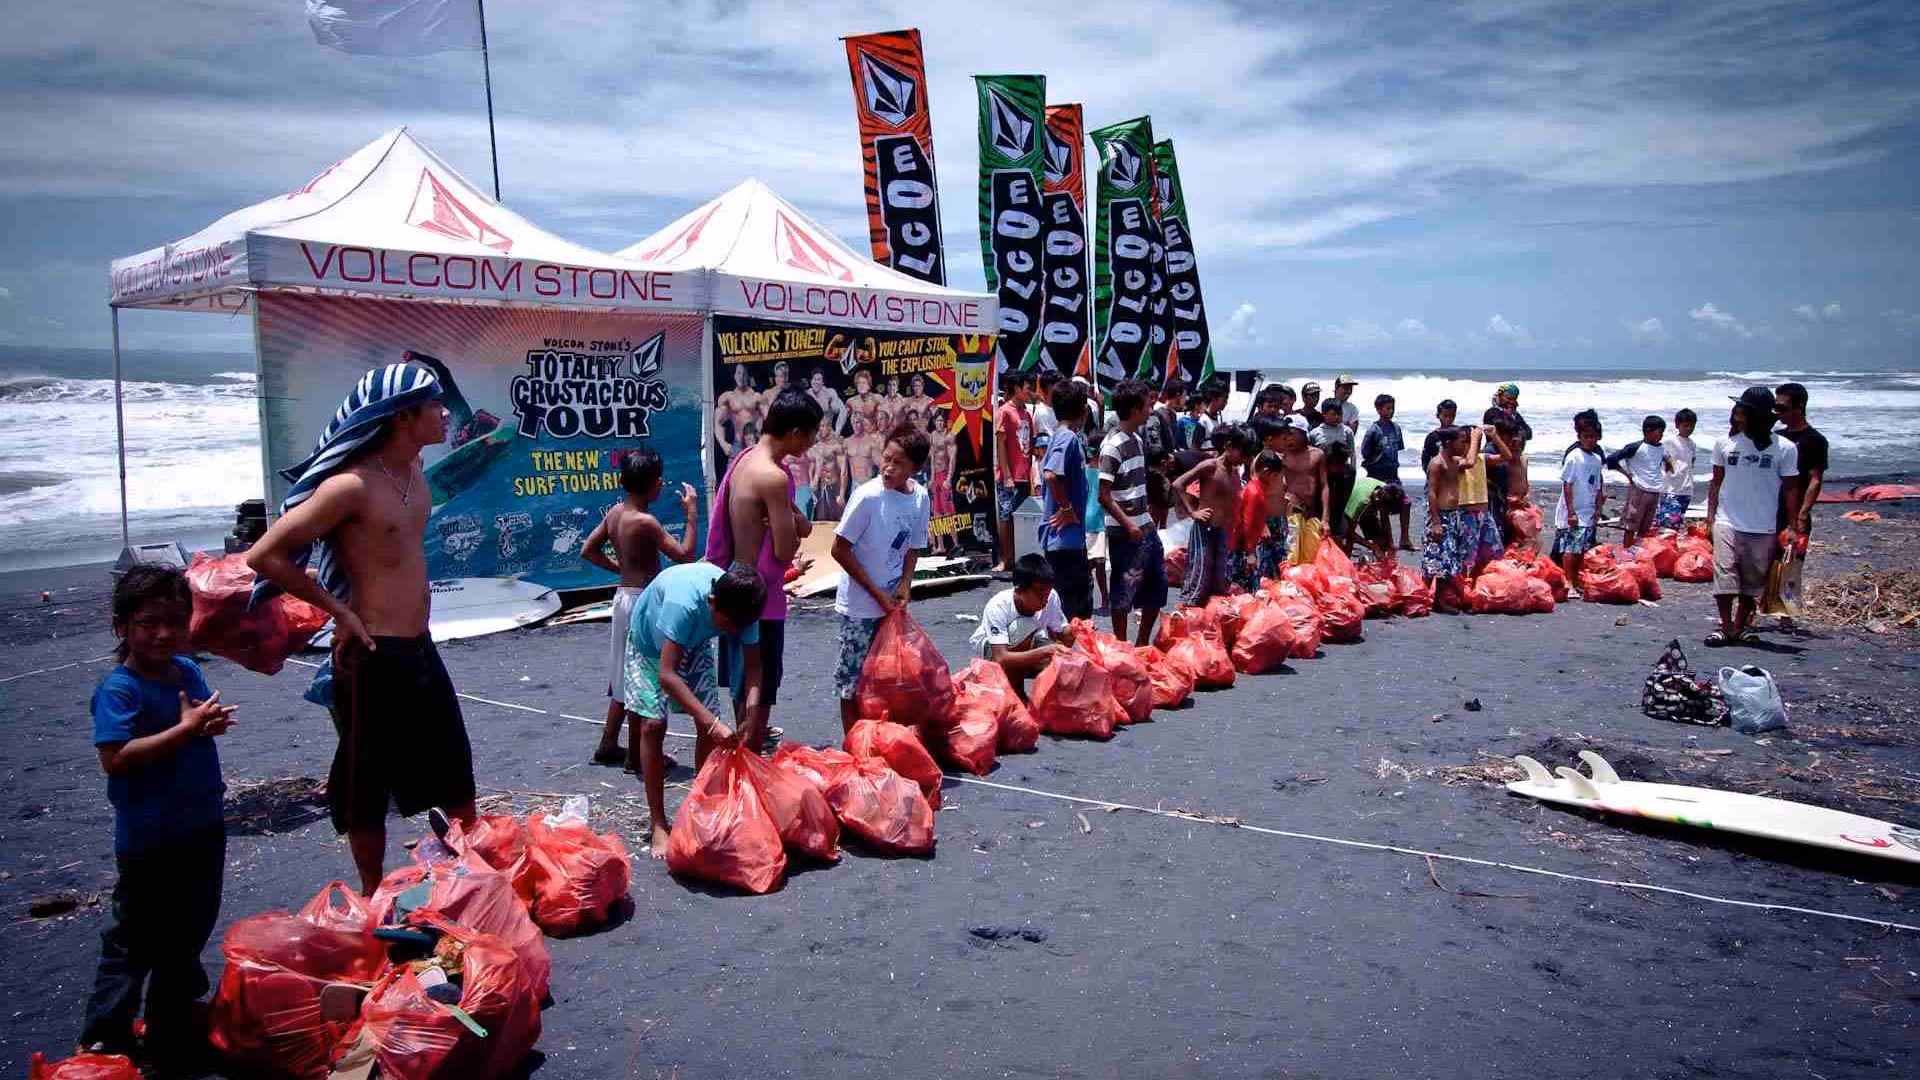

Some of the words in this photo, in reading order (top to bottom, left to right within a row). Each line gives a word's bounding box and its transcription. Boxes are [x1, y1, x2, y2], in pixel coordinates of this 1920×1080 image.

[299, 243, 523, 294] VOLCOM
[534, 264, 673, 303] STONE
[740, 279, 878, 321] VOLCOM
[886, 296, 980, 328] STONE
[543, 337, 585, 350] VOLCOM
[879, 340, 897, 357] YOU
[527, 350, 625, 382] TOTALLY
[881, 358, 898, 376] THE
[511, 376, 668, 412] CRUSTACEOUS
[513, 403, 651, 440] TOUR
[531, 450, 564, 472] THE
[565, 449, 600, 471] NEW
[514, 475, 557, 497] SURF
[560, 473, 600, 493] TOUR
